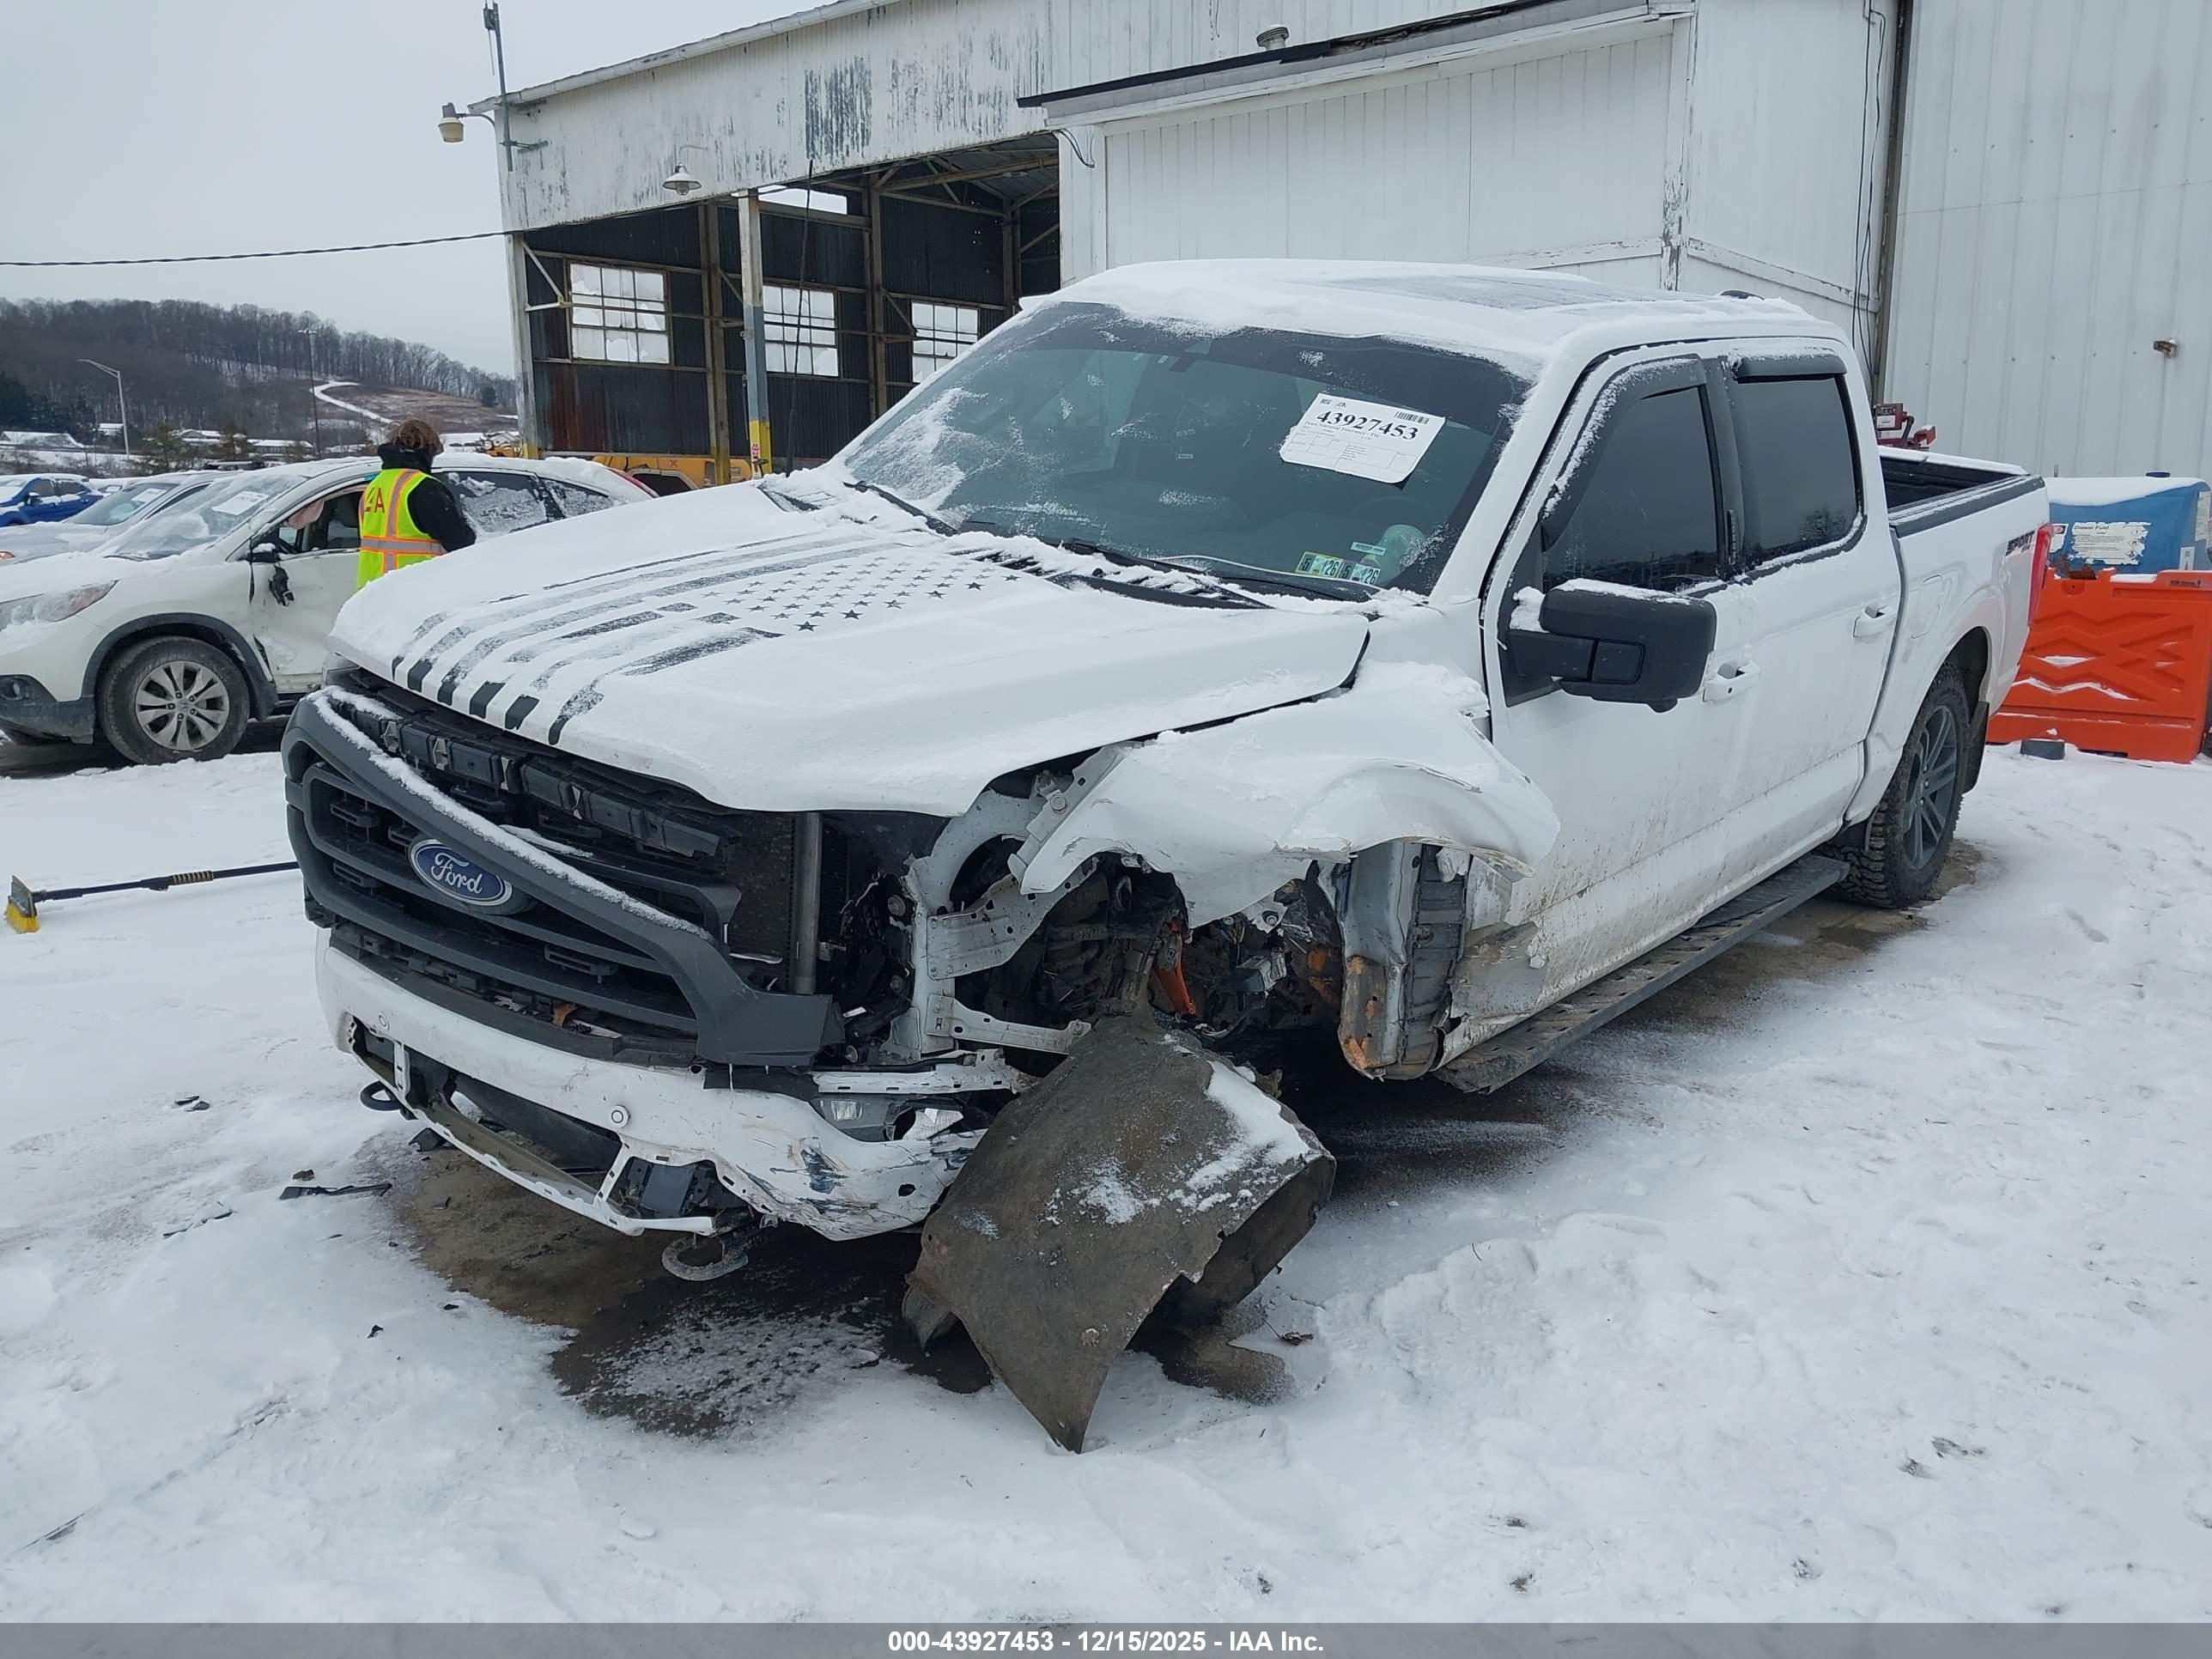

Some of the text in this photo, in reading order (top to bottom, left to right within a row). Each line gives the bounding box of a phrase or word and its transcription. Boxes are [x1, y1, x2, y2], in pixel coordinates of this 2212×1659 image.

[1316, 410, 1419, 441] 43927453
[2005, 530, 2035, 556] SPORT
[430, 852, 483, 894] Ford
